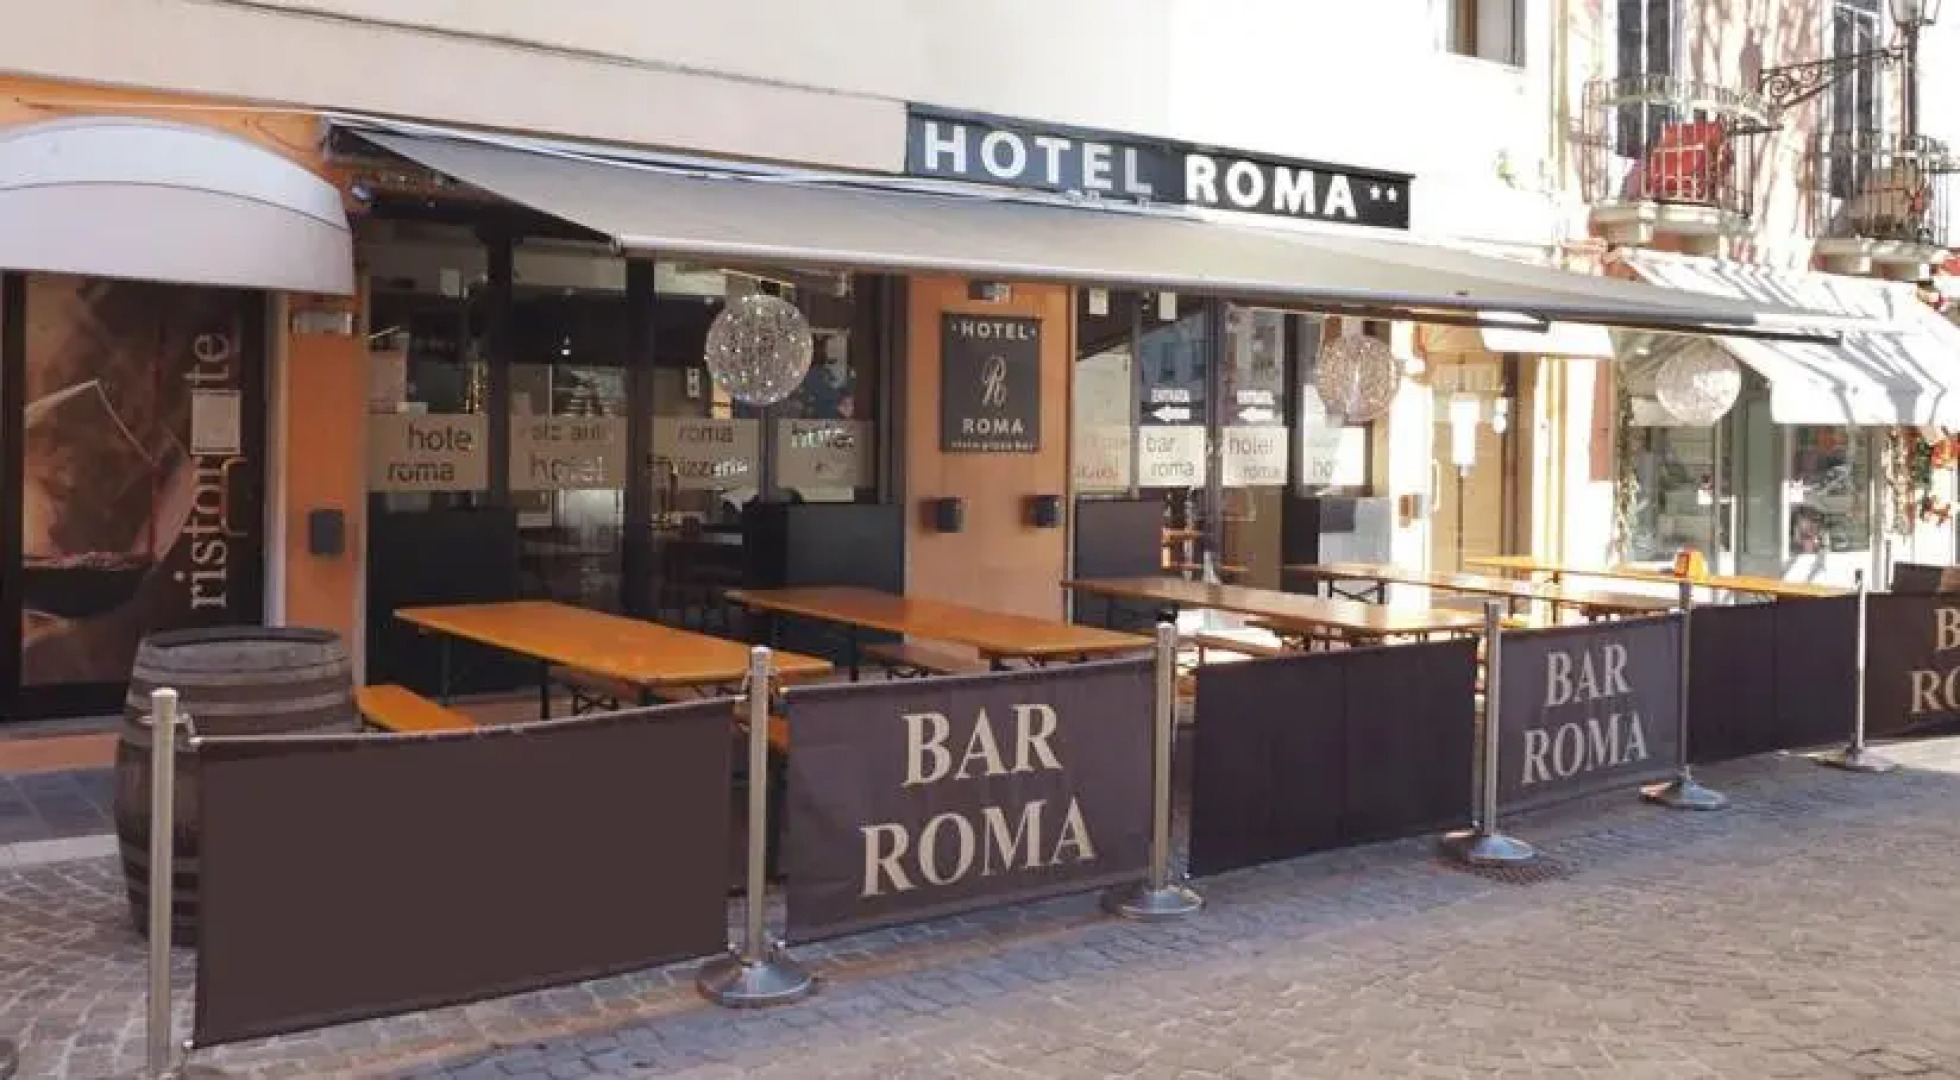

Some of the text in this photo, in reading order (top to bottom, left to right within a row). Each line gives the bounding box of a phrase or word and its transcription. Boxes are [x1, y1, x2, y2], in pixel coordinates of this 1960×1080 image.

[924, 121, 1358, 218] HOTEL ROMA
[961, 322, 1029, 340] HOTEL
[962, 418, 1025, 434] ROMA
[174, 333, 230, 610] ristorte
[1545, 643, 1632, 708] BAR
[901, 702, 1064, 788] BAR
[1521, 713, 1649, 784] ROMA
[859, 796, 1096, 897] ROMA
